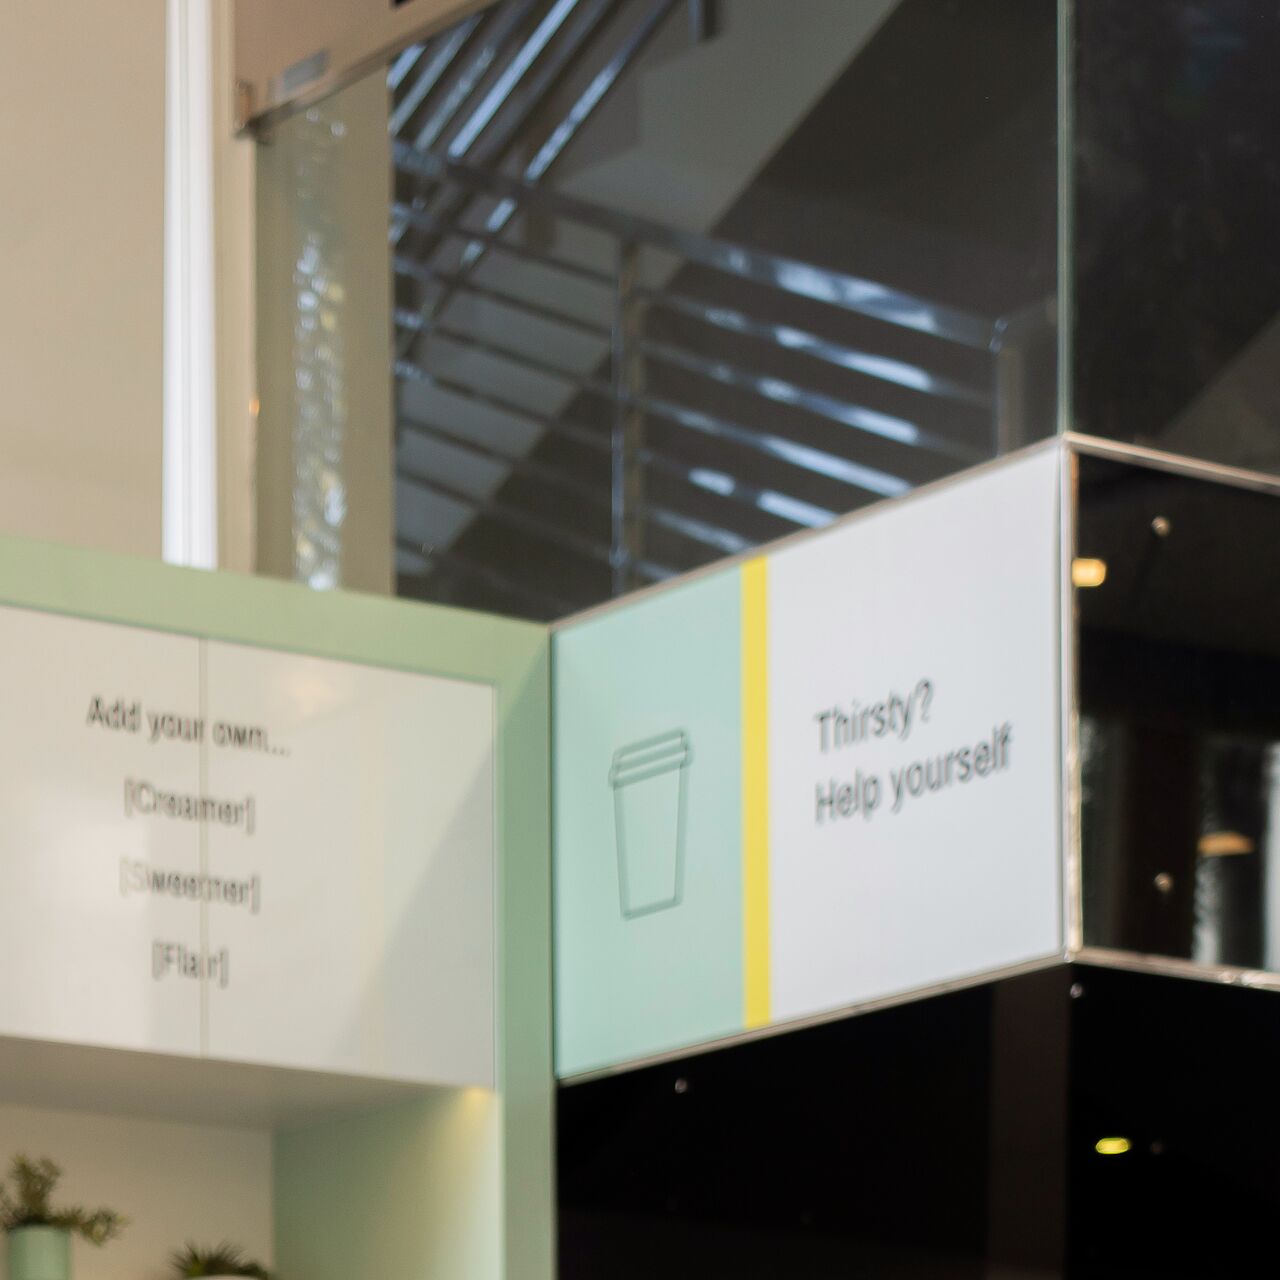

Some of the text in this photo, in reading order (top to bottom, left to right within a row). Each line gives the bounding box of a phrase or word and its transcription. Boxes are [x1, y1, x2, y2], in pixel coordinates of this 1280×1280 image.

[87, 695, 141, 732] Add
[147, 711, 204, 743] your
[815, 678, 934, 752] Thirsty?
[814, 721, 1013, 822] Help yourself
[124, 776, 255, 835] [Creamer]
